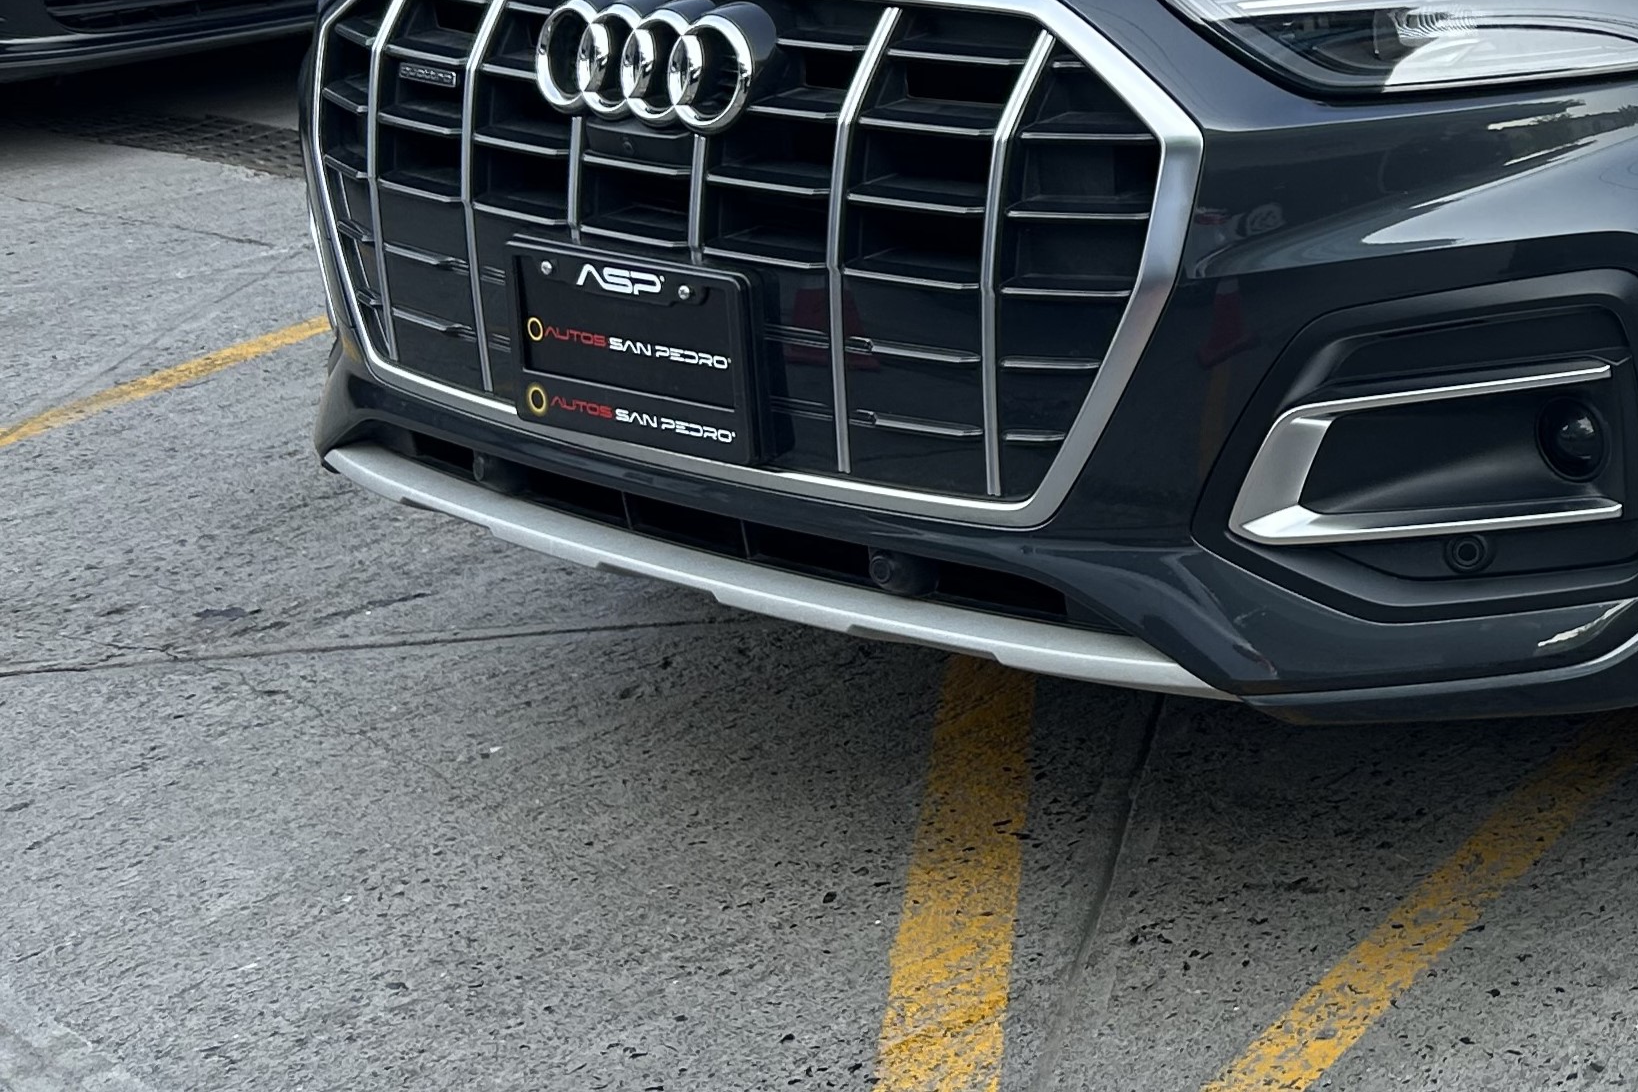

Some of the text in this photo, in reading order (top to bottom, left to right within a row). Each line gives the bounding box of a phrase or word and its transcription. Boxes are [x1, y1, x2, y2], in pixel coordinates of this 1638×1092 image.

[576, 263, 662, 295] ASP
[545, 325, 729, 370] AUTOS SAN PEDRO
[551, 395, 734, 443] AUTOS SAN PEDRO
